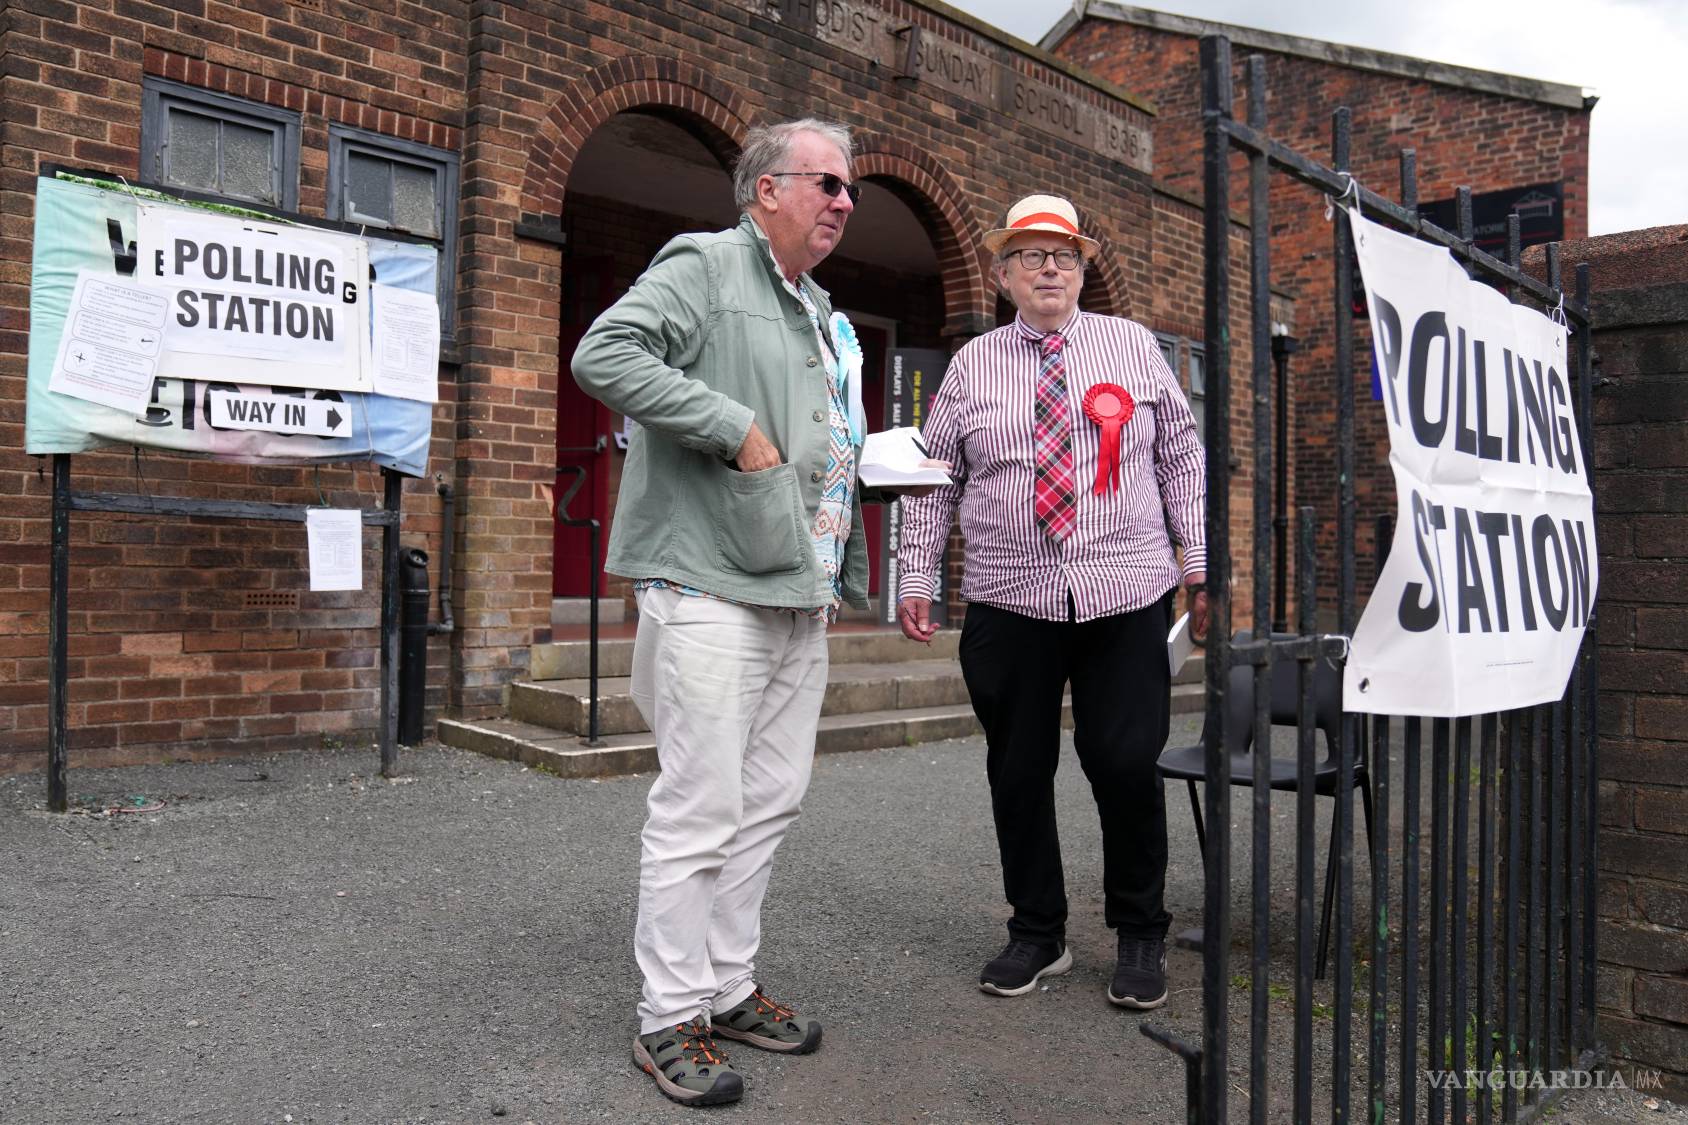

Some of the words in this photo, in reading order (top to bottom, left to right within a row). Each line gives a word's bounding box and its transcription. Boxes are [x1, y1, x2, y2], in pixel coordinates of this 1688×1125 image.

[916, 40, 986, 95] SUNDAY
[1014, 83, 1083, 136] SCHOOL
[174, 238, 335, 296] POLLING
[176, 289, 335, 342] STATION
[893, 355, 903, 396] DISPLAYS
[913, 370, 922, 387] FOR
[913, 388, 922, 402] ALL
[1372, 289, 1577, 476] POLLING
[226, 398, 277, 424] WAY
[284, 403, 306, 427] IN
[893, 403, 902, 423] SALE
[913, 403, 921, 417] THE
[1399, 488, 1590, 634] STATION
[887, 557, 897, 623] REFRESHMENTS
